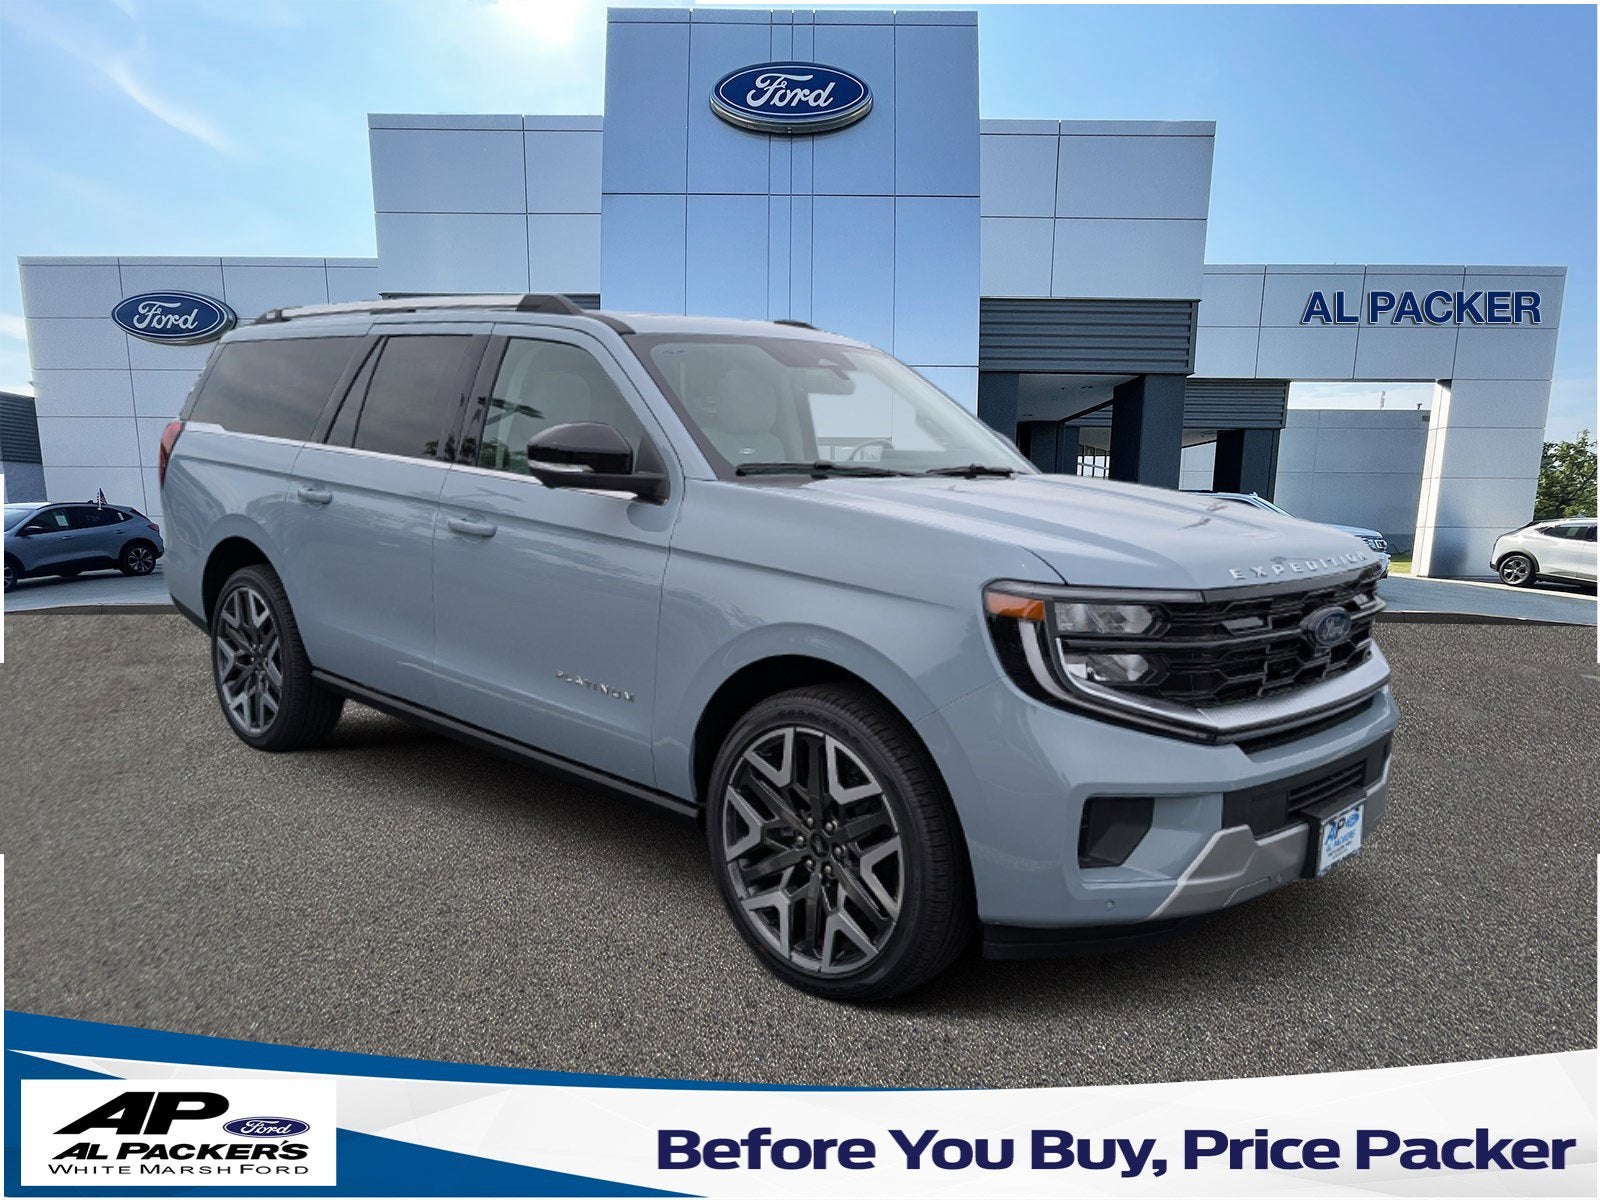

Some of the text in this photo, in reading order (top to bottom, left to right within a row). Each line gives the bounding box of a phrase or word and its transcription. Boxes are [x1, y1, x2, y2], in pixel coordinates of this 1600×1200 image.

[746, 73, 836, 107] Ford
[133, 301, 199, 329] Ford
[1301, 290, 1542, 324] AL PACKER
[1229, 551, 1368, 581] EXPEDITION
[556, 670, 635, 702] PLATINUM
